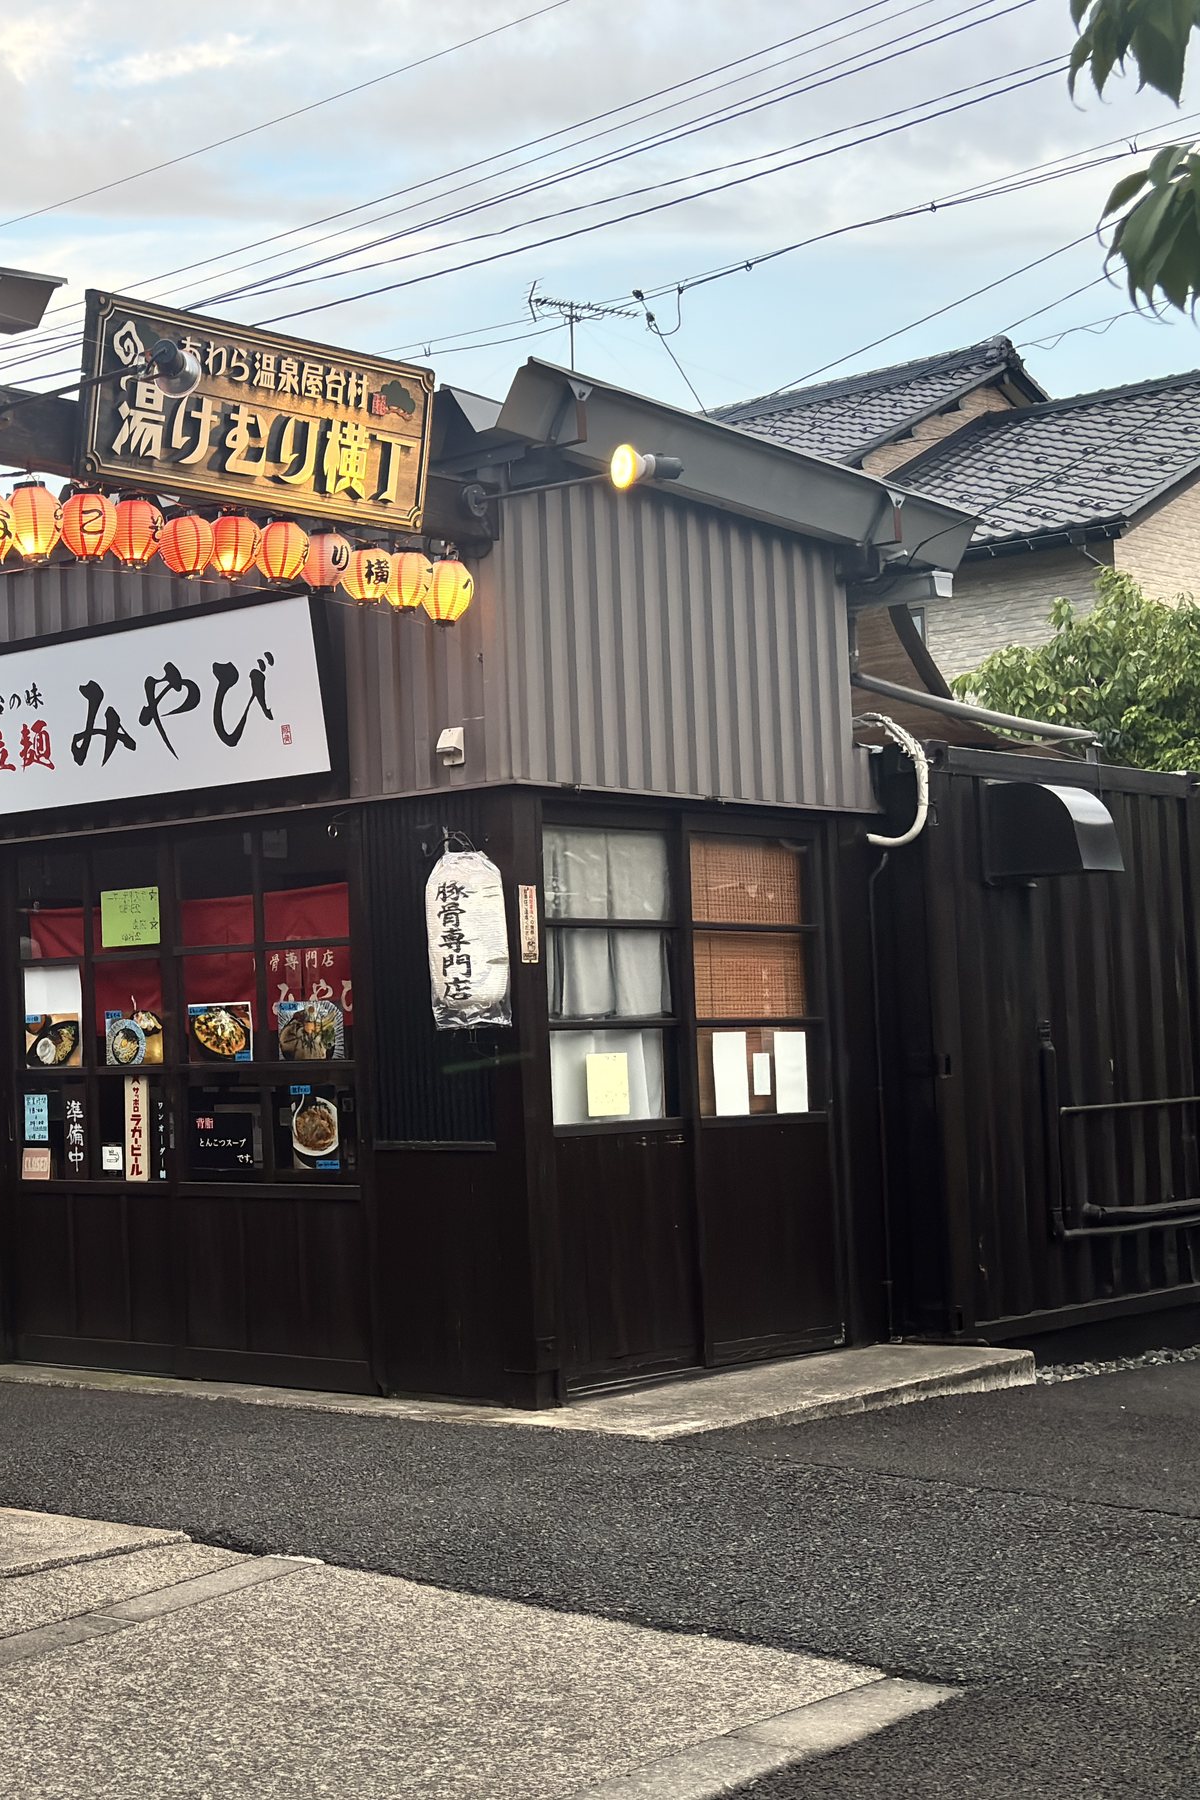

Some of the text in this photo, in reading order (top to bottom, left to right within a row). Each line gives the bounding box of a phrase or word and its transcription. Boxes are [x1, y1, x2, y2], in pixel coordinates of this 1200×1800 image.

[112, 374, 417, 504] 湯けむり横丁
[71, 651, 275, 767] みやび
[269, 949, 335, 972] 骨専門店
[435, 881, 472, 1001] 豚骨専門店
[66, 1100, 84, 1172] 準備中
[199, 1138, 246, 1147] とんこつスープ
